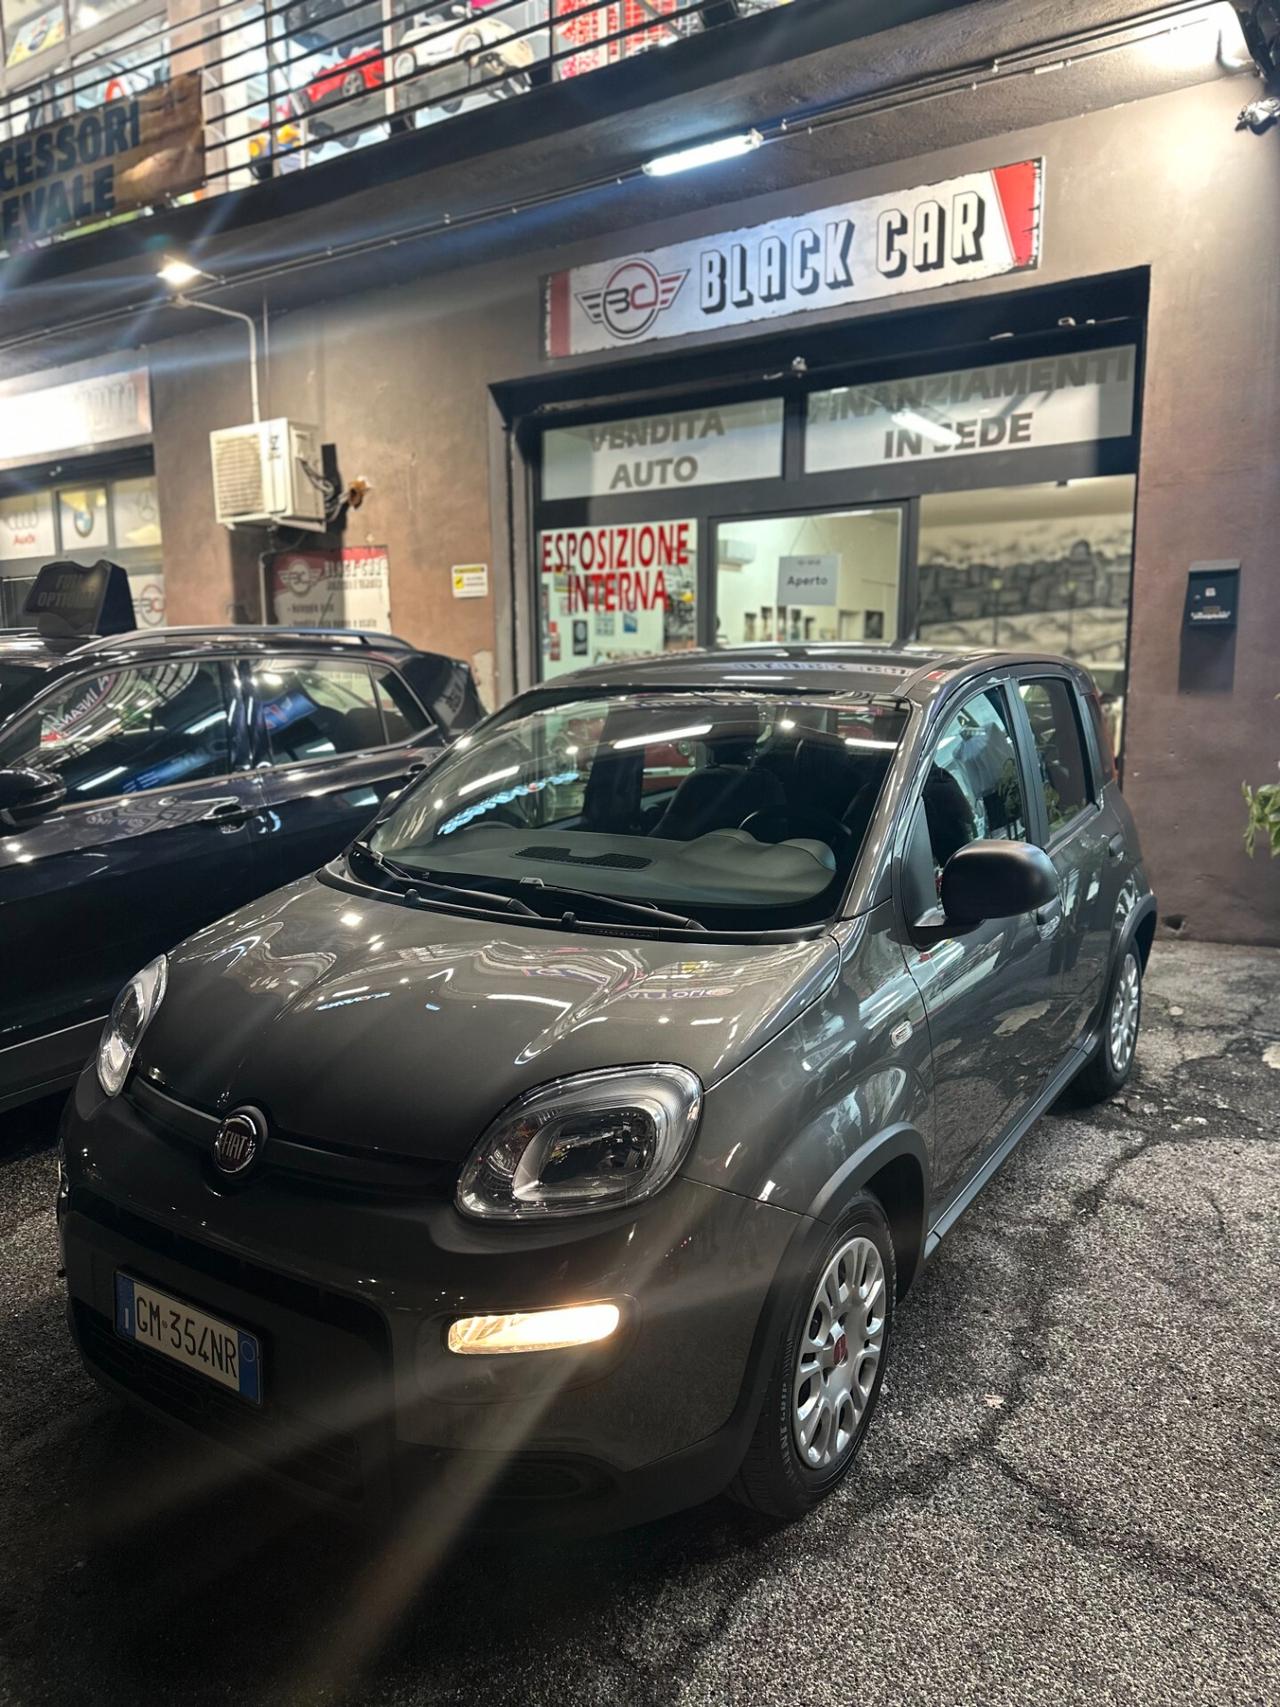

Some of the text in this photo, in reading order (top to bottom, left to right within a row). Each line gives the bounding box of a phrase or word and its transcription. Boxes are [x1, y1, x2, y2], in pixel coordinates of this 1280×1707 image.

[2, 164, 116, 236] EVALE
[700, 190, 985, 314] BLACK CAR
[590, 410, 725, 452] VENDITA
[884, 428, 923, 460] IN
[609, 455, 698, 490] AUTO
[541, 523, 689, 573] ESPOSIZIONE
[567, 569, 671, 614] INTERNA
[786, 575, 829, 589] Aperto
[221, 1130, 249, 1160] FIAT
